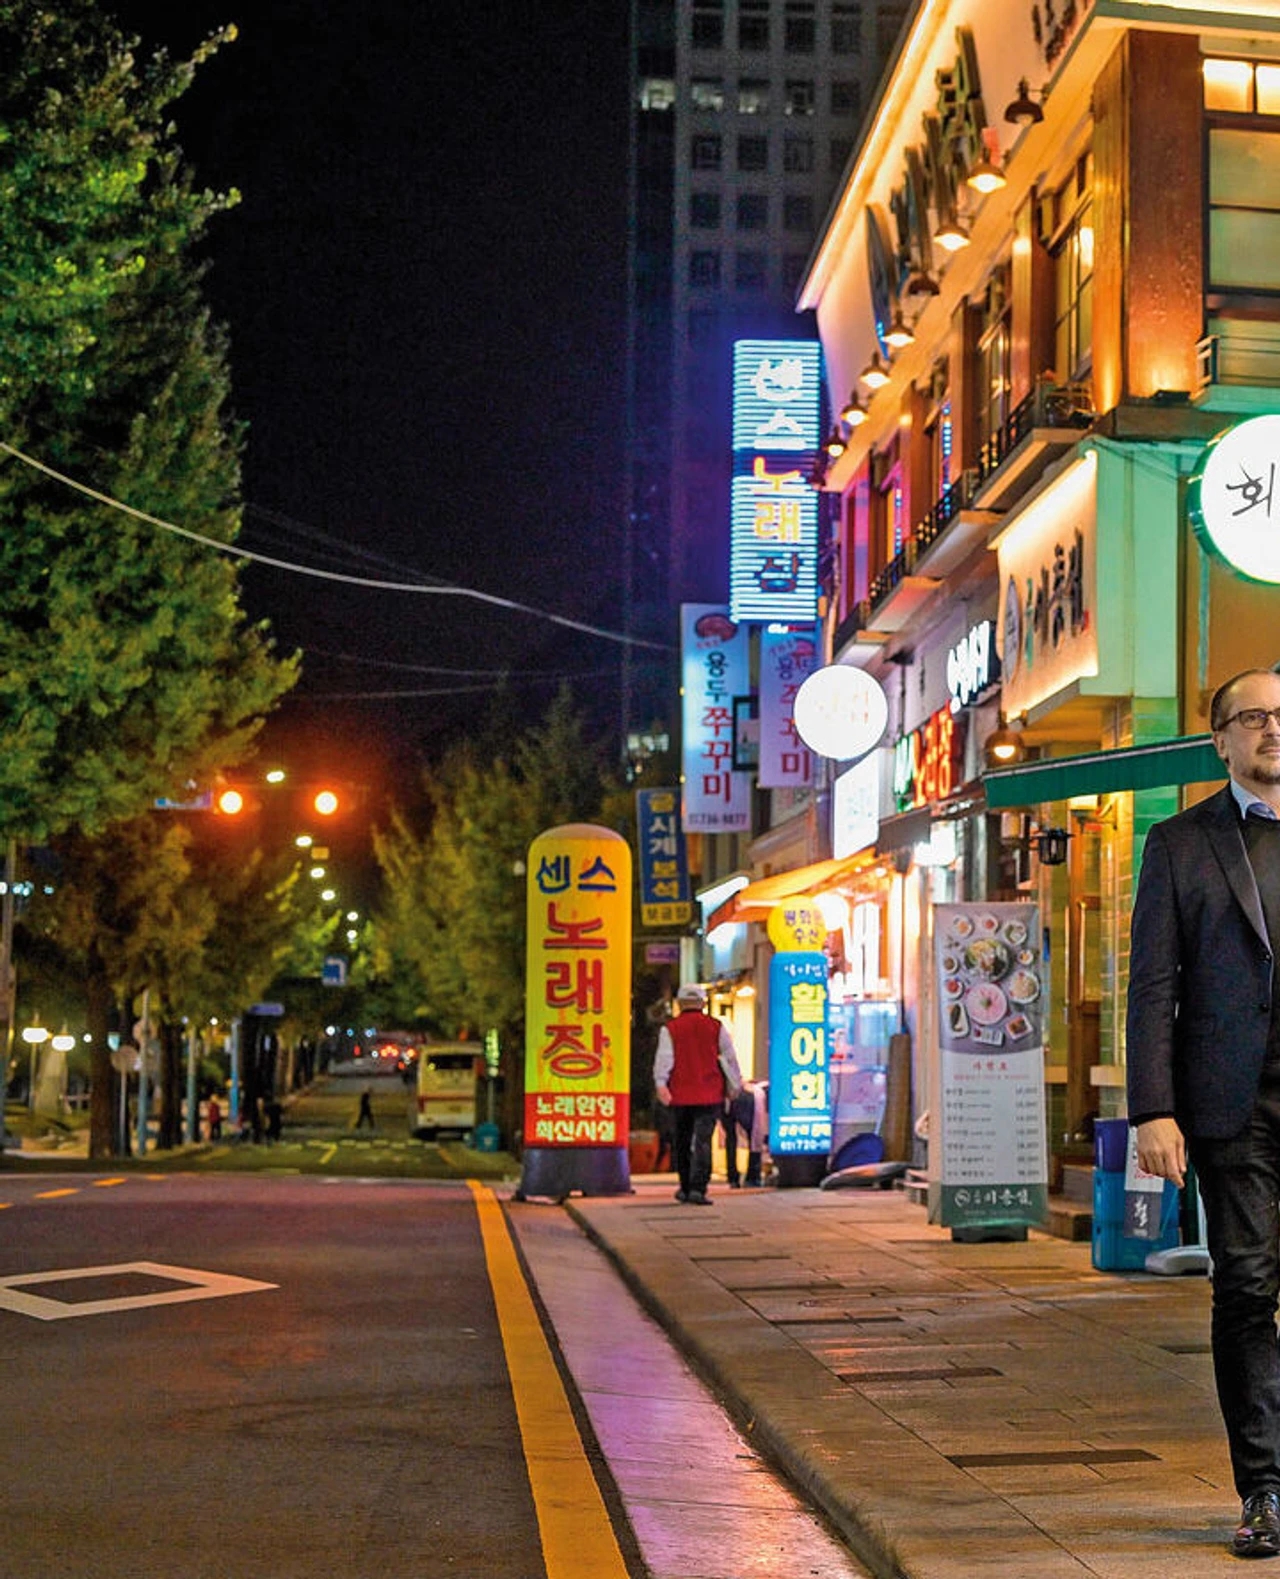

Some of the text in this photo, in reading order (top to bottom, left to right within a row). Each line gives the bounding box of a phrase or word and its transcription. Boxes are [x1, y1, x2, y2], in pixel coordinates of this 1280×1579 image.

[534, 854, 618, 894] 센스
[542, 901, 610, 1079] 노래장
[789, 982, 827, 1110] 활어회
